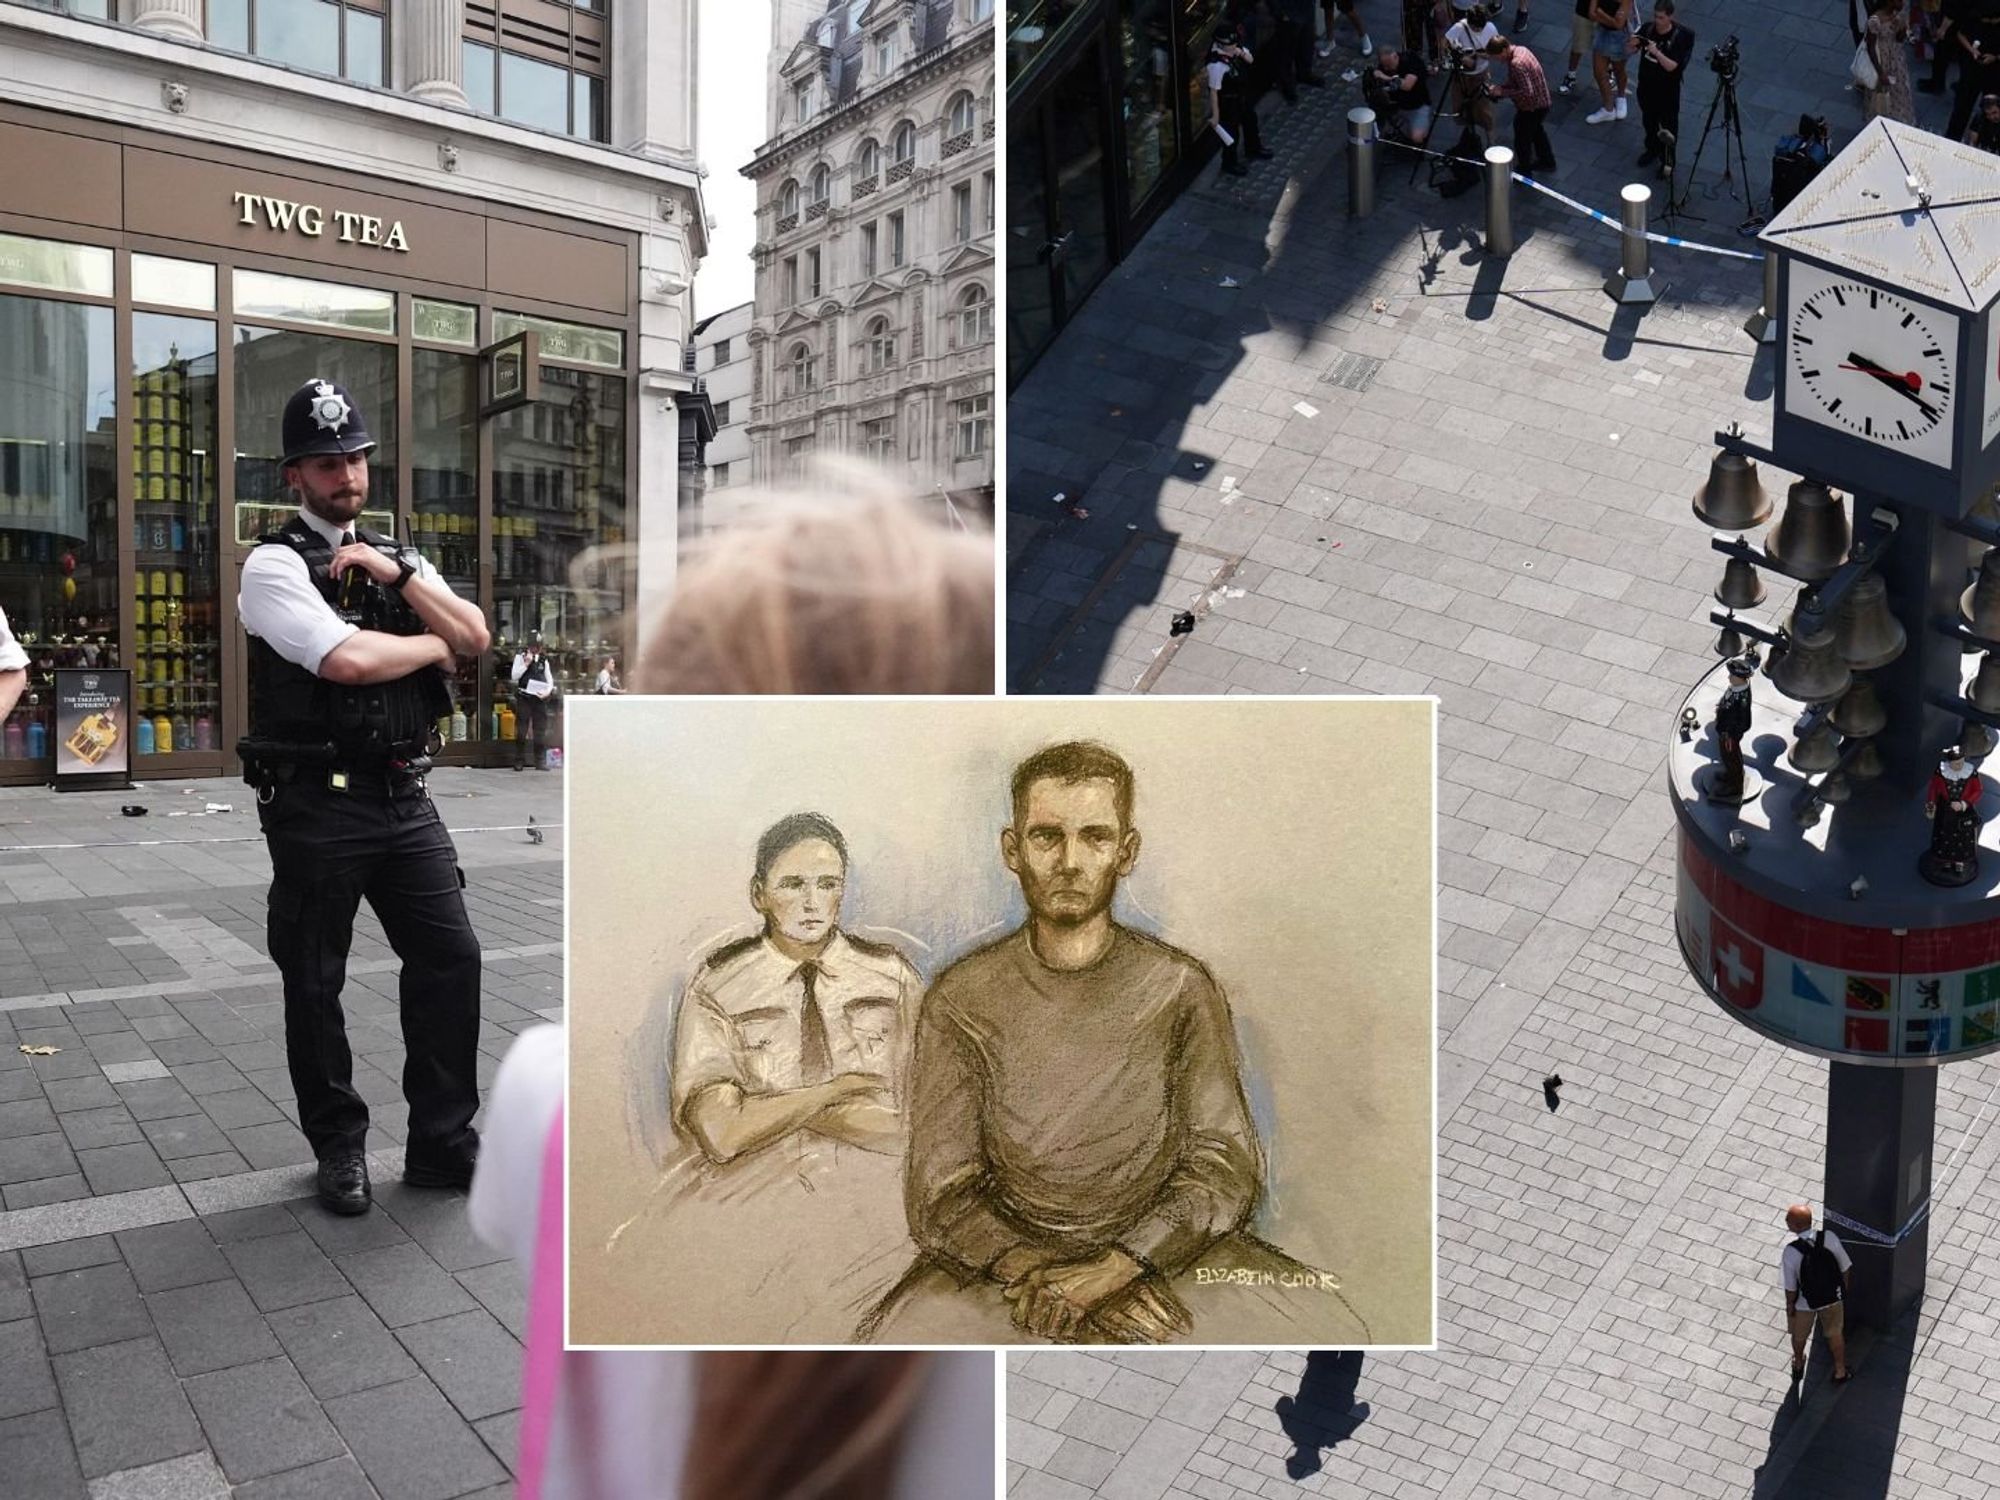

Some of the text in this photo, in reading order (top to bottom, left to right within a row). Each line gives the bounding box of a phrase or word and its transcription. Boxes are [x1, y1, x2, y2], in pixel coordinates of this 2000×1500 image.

[234, 191, 411, 252] TWG TEA
[1280, 1271, 1341, 1290] COOK
